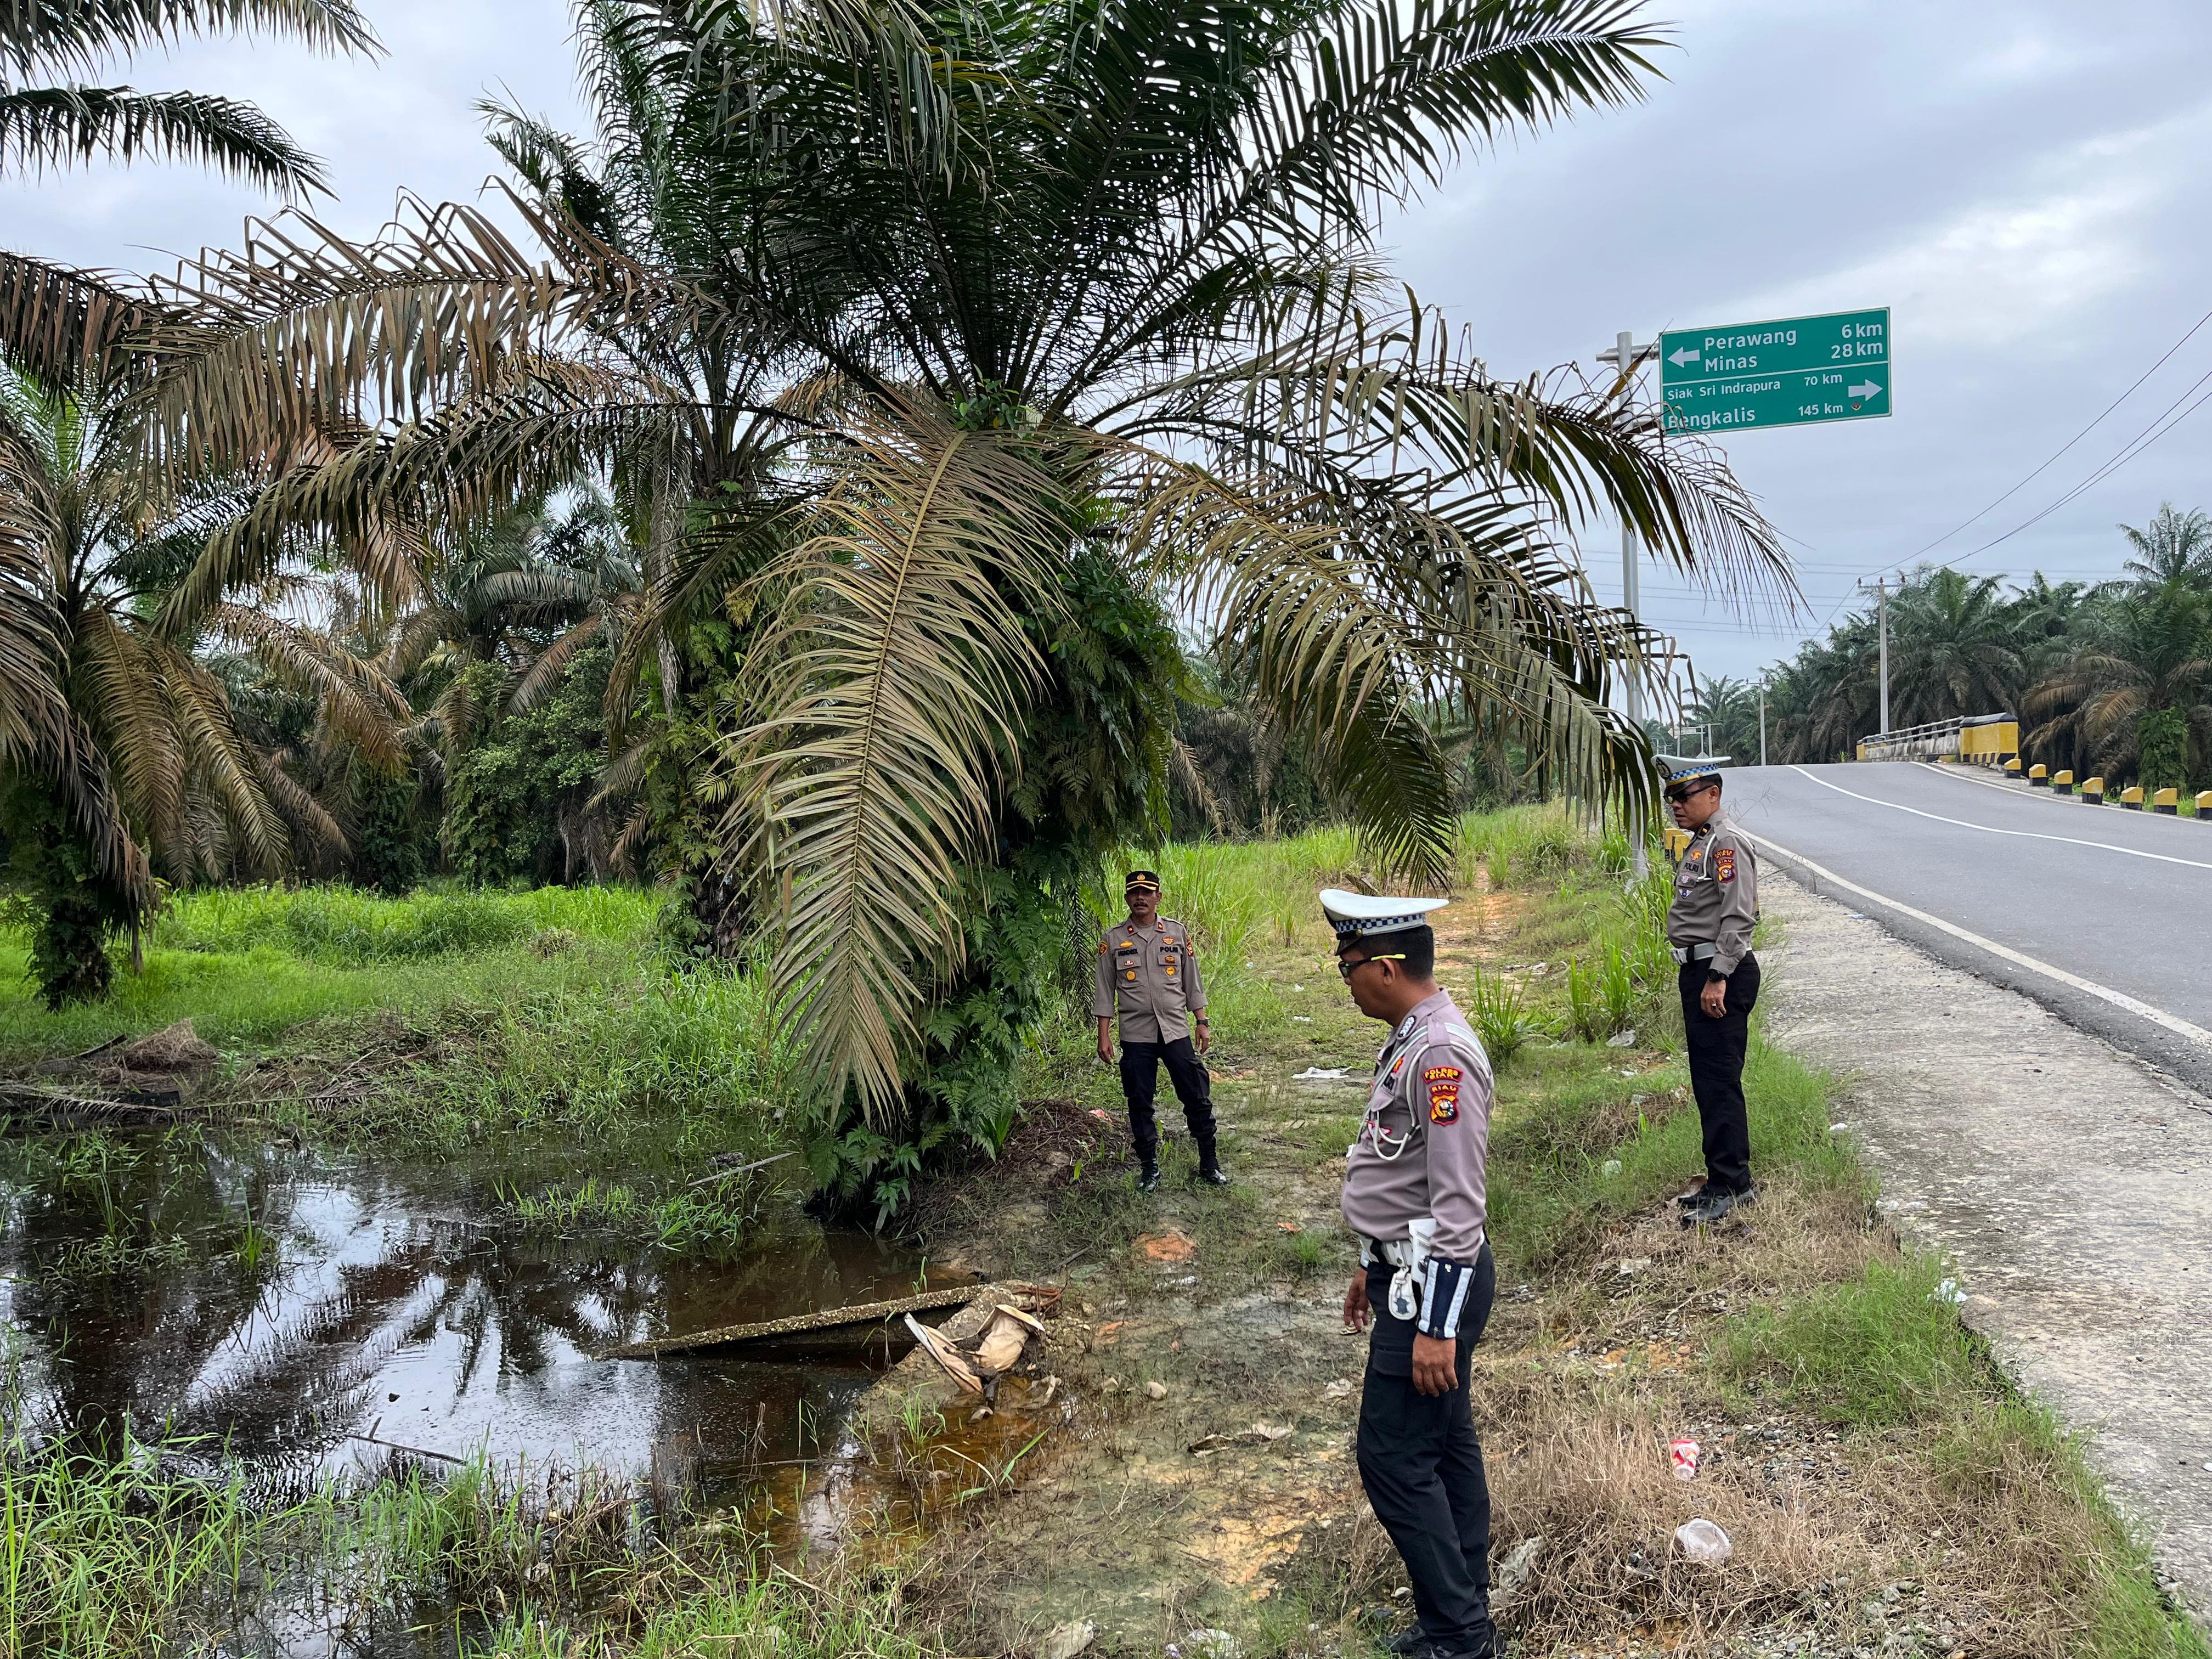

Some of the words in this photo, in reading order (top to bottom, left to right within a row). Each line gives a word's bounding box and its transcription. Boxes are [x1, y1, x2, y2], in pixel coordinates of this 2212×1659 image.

[1841, 324, 1853, 338] 6
[1855, 323, 1882, 337] km
[1705, 330, 1797, 351] Perawang
[1831, 345, 1853, 359] 28
[1857, 341, 1883, 355] km
[1705, 355, 1758, 373] Minas
[1804, 376, 1818, 386] 70
[1822, 373, 1843, 385] km
[1667, 387, 1693, 400] Siak
[1700, 385, 1716, 397] Sri
[1721, 380, 1781, 395] Indrapura
[1798, 404, 1819, 417] 145
[1824, 403, 1843, 414] km
[1668, 407, 1756, 430] Bengkalis
[1683, 862, 1700, 872] POLRI
[1425, 1068, 1458, 1078] POLRES
